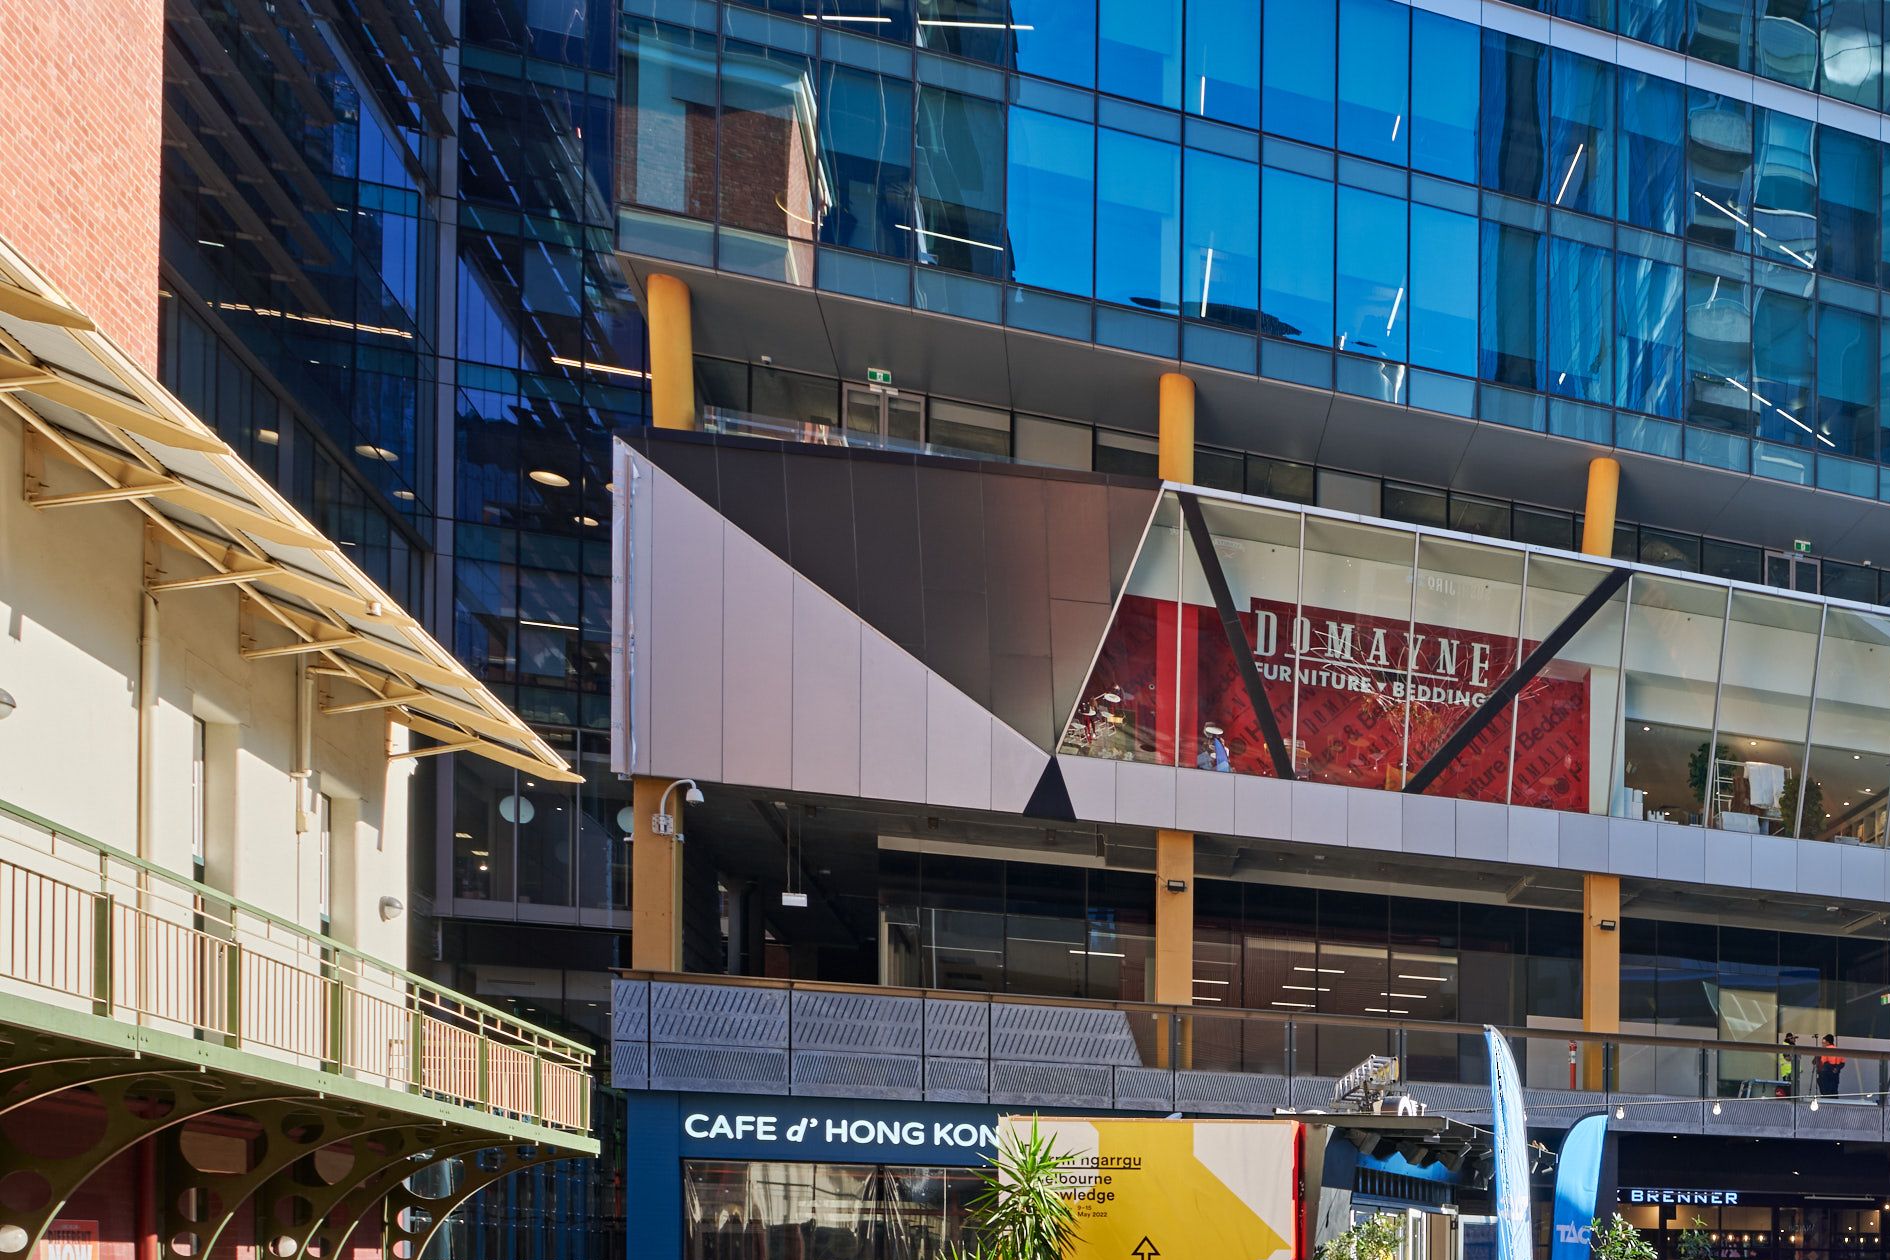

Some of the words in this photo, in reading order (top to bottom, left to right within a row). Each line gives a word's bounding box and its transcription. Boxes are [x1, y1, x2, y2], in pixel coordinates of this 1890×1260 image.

[1254, 610, 1490, 688] DOMAYNE
[1254, 662, 1372, 694] FURNITURE
[1392, 681, 1488, 709] BEDDING
[684, 1113, 777, 1141] CAFE
[826, 1119, 925, 1146] HONG
[933, 1122, 1000, 1148] KON
[1081, 1155, 1142, 1169] ngarrgu
[1040, 1173, 1113, 1185] elbourne
[1056, 1188, 1115, 1204] wledge
[1631, 1189, 1738, 1205] BRENNER
[48, 1230, 92, 1245] DIFFERENT
[1556, 1220, 1592, 1245] TAC
